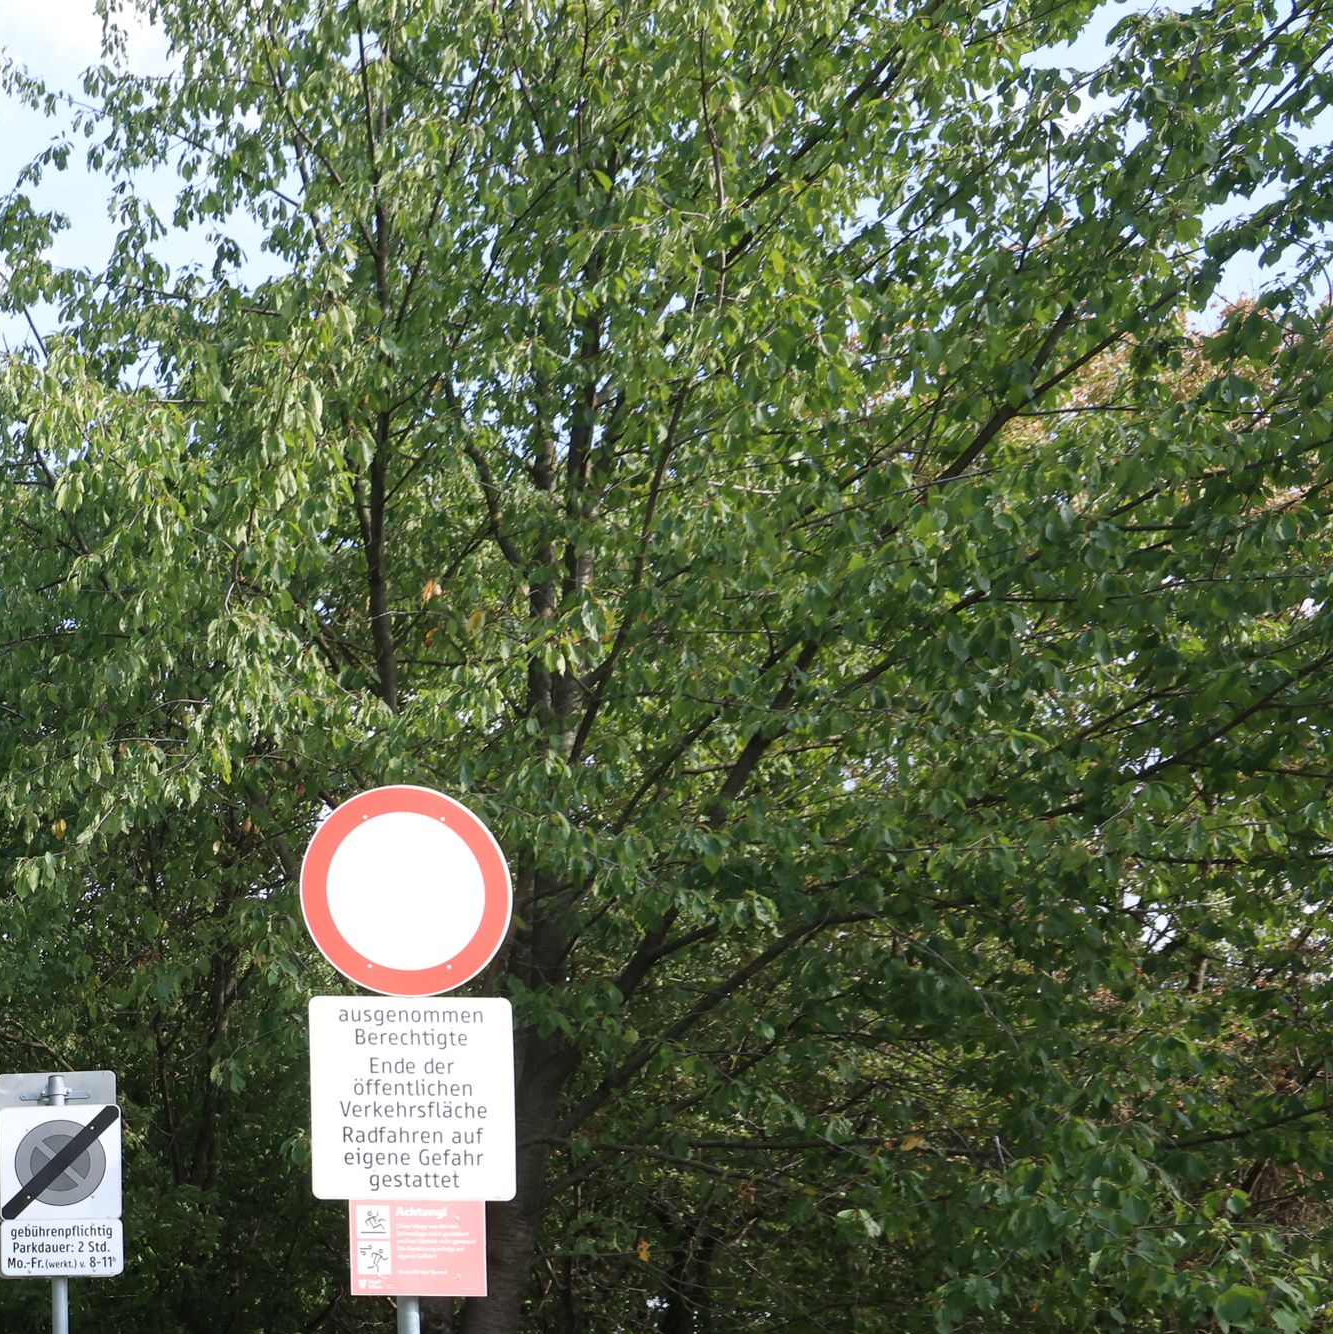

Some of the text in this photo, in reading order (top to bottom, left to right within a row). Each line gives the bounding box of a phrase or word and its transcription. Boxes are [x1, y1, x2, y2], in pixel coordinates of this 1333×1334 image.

[338, 1008, 484, 1027] ausgenommen
[354, 1028, 468, 1050] Berechtigte
[369, 1056, 455, 1075] Ende der
[353, 1077, 473, 1097] öffentlichen
[339, 1100, 488, 1119] Verkehrsfläche
[342, 1125, 484, 1145] Radfahren auf
[343, 1147, 484, 1169] eigene Gefahr
[369, 1172, 460, 1192] gestattet
[395, 1206, 448, 1221] Achtung!
[10, 1224, 113, 1240] gebührenpflichtig
[12, 1240, 111, 1253] Parkdauer: 2 Std.
